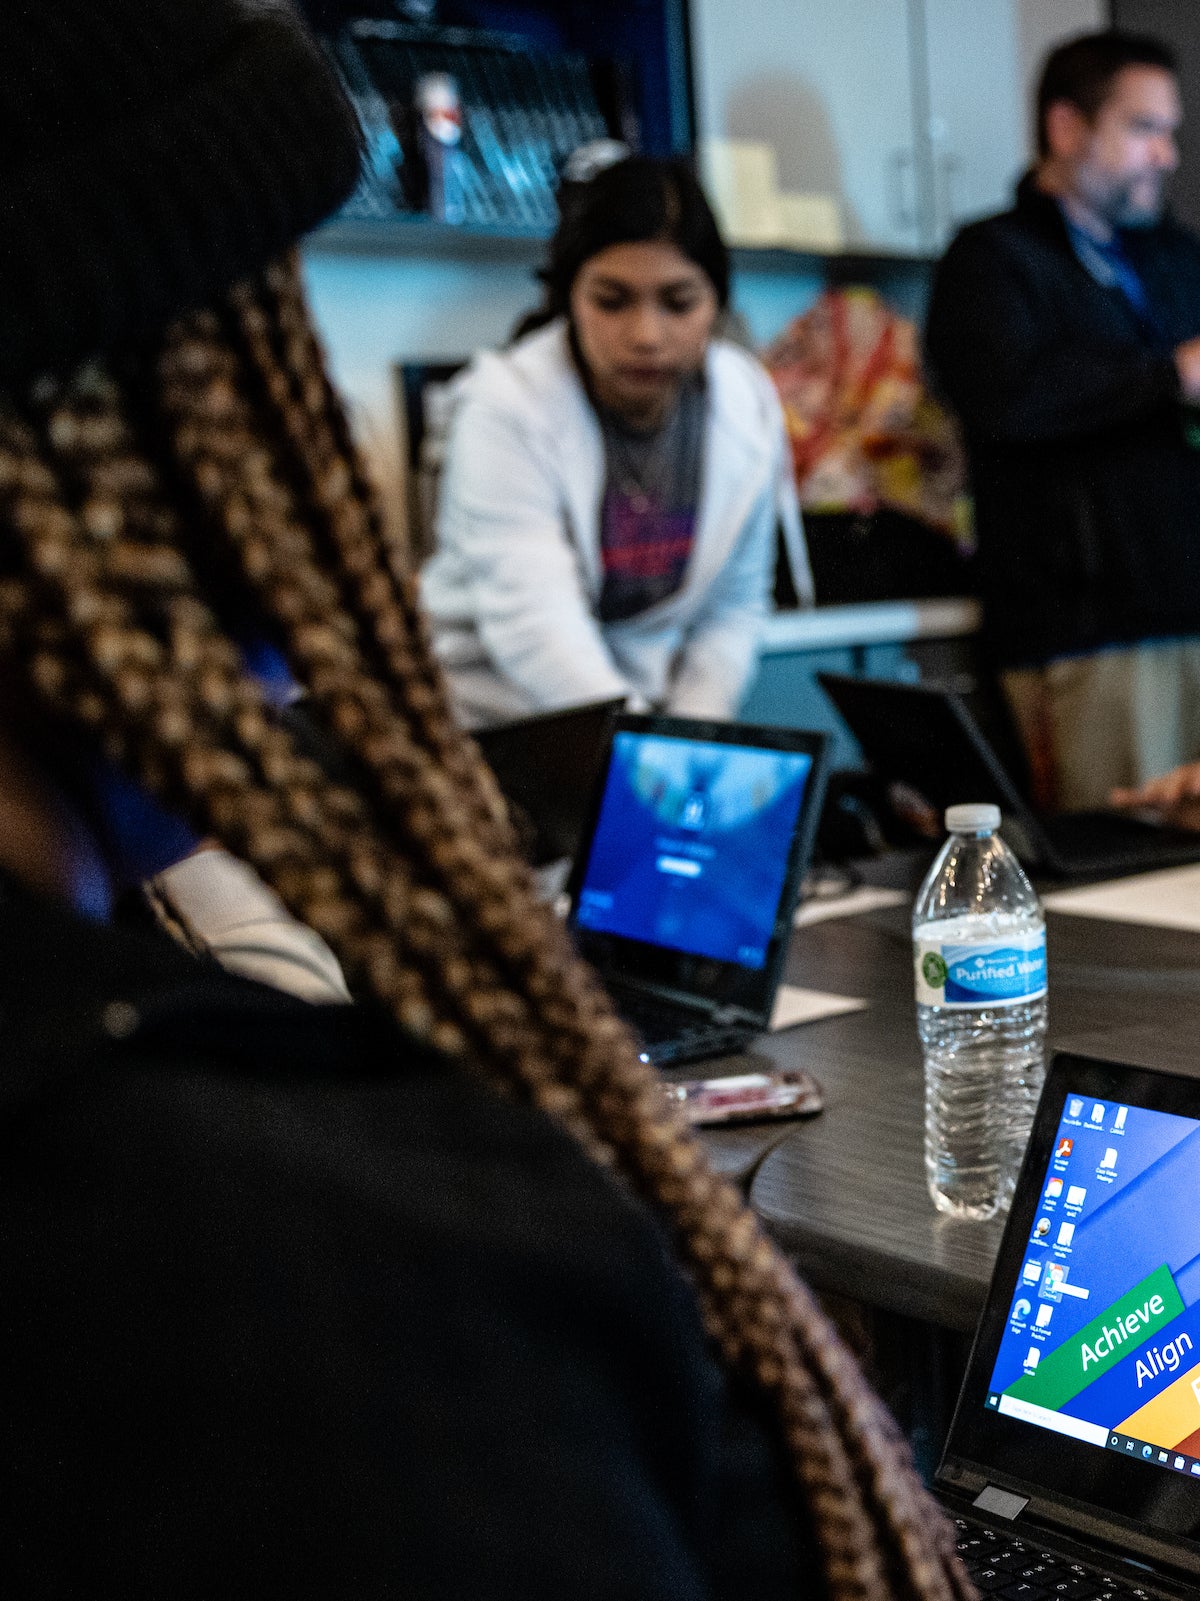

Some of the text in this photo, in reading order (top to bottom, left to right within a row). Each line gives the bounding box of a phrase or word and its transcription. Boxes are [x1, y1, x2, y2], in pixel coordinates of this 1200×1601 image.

[956, 964, 1015, 980] Purified
[1081, 1294, 1165, 1371] Achieve
[1135, 1332, 1193, 1388] Align
